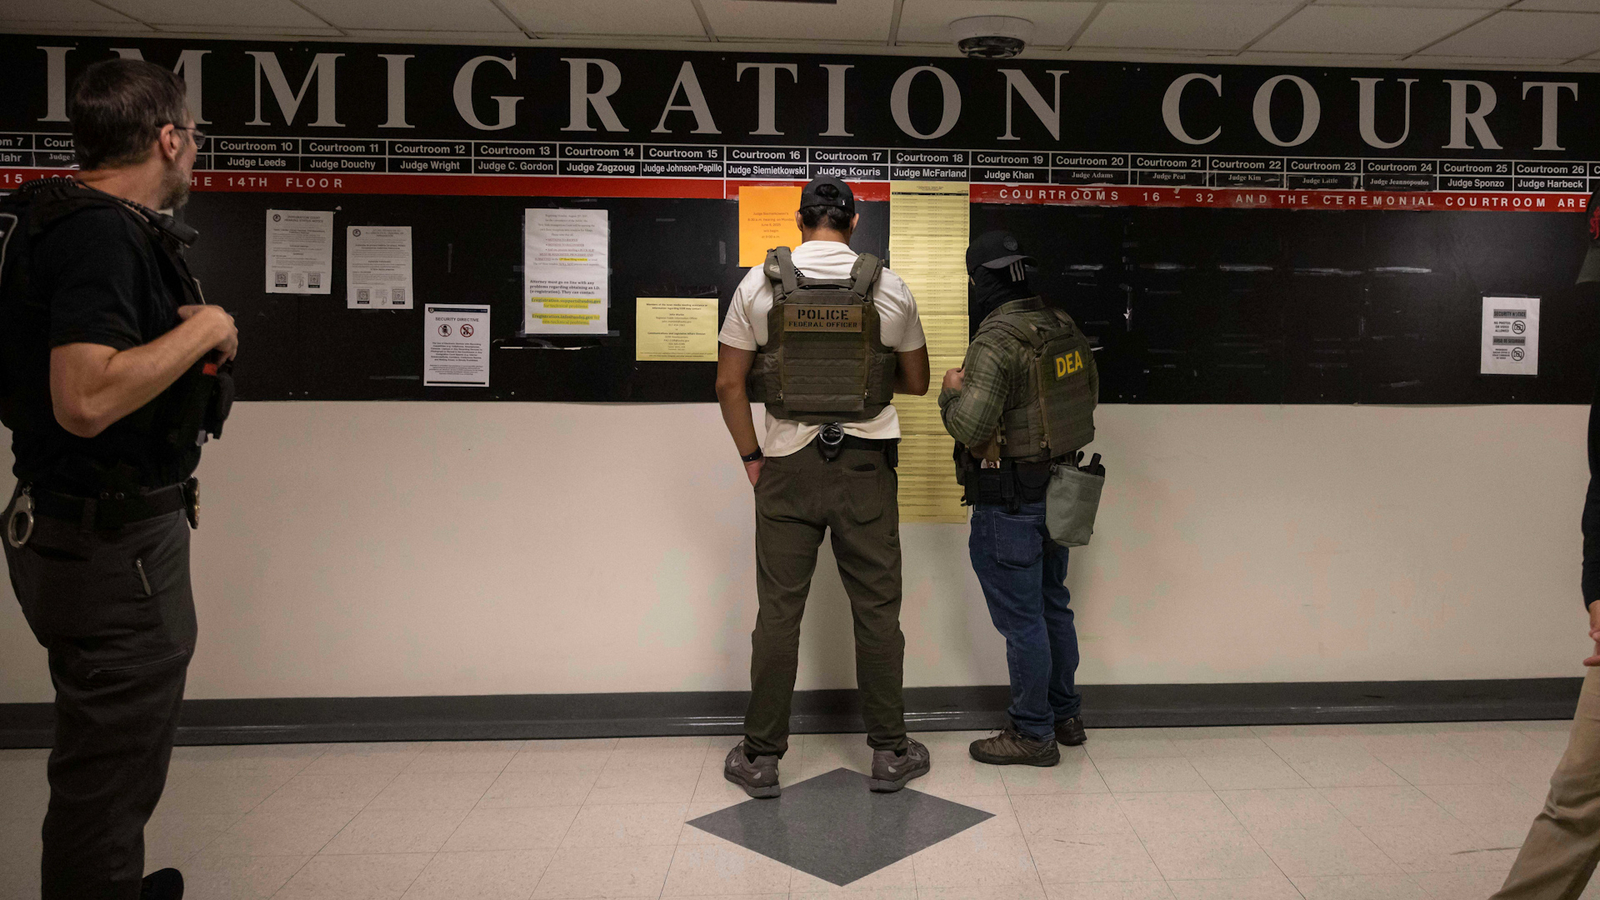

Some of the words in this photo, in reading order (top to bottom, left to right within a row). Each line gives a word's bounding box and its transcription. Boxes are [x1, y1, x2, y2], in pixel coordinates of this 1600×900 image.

[37, 46, 1070, 141] IMMIGRATION
[1162, 72, 1579, 151] COURT
[17, 137, 24, 147] 7
[44, 138, 75, 148] Court
[220, 141, 276, 151] Courtroom
[281, 142, 292, 151] 10
[309, 143, 365, 153] Courtroom
[370, 144, 379, 153] 11
[395, 144, 450, 154] Courtroom
[454, 145, 465, 154] 12
[480, 146, 535, 155] Courtroom
[539, 146, 550, 156] 13
[565, 147, 619, 157] Courtroom
[623, 148, 634, 157] 14
[649, 148, 703, 158] Courtroom
[707, 149, 718, 158] 15
[49, 153, 70, 162] Judge
[732, 150, 786, 160] Courtroom
[789, 151, 800, 160] 16
[815, 152, 868, 161] Courtroom
[872, 152, 882, 162] 17
[896, 153, 948, 163] Courtroom
[953, 154, 963, 163] 18
[977, 154, 1029, 164] Courtroom
[1033, 155, 1044, 164] 19
[227, 157, 257, 168] Judge
[259, 158, 286, 167] Leeds
[310, 159, 339, 170] Judge
[341, 160, 376, 171] Douchy
[400, 160, 429, 171] Judge
[431, 161, 460, 172] Wright
[1056, 156, 1108, 166] Courtroom
[1111, 157, 1124, 166] 20
[1136, 158, 1187, 167] Courtroom
[1190, 158, 1201, 168] 21
[1212, 159, 1264, 169] Courtroom
[1268, 160, 1281, 169] 22
[1291, 161, 1340, 171] Courtroom
[1344, 162, 1356, 171] 23
[478, 161, 506, 172] Judge
[508, 162, 518, 171] C.
[520, 162, 554, 172] Gordon
[567, 163, 595, 173] Judge
[597, 163, 635, 174] Zagzoug
[643, 164, 665, 174] Judge
[666, 164, 722, 175] Johnson-Papillo
[728, 165, 750, 176] Judge
[752, 165, 806, 176] Siemietkowski
[817, 166, 848, 177] Judge
[850, 166, 881, 176] Kouris
[1368, 162, 1418, 172] Courtroom
[1420, 163, 1432, 172] 24
[1444, 164, 1493, 173] Courtroom
[1496, 164, 1508, 174] 25
[1517, 165, 1568, 175] Courtroom
[1572, 166, 1585, 175] 26
[894, 168, 921, 178] Judge
[922, 168, 967, 178] McFarland
[984, 170, 1010, 180] Judge
[1012, 170, 1035, 180] Khan
[1071, 172, 1091, 180] Judge
[1152, 173, 1172, 181] Judge
[1228, 174, 1247, 182] Judge
[4, 174, 23, 184] 15
[190, 178, 213, 187] HE
[228, 178, 268, 187] 14TH
[286, 178, 342, 188] FLOOR
[1302, 177, 1321, 185] Judge
[1370, 178, 1388, 186] Judge
[1448, 179, 1473, 189] Judge
[1474, 179, 1505, 189] Sponzo
[1518, 179, 1545, 190] Judge
[1547, 179, 1584, 189] Harbeck
[1000, 189, 1119, 201] COURTROOMS
[1143, 192, 1160, 202] 16
[1196, 193, 1214, 203] 32
[1235, 194, 1267, 204] AND
[1279, 194, 1309, 204] THE
[1323, 195, 1434, 206] CEREMONIAL
[1445, 196, 1546, 208] COURTROOM
[1557, 198, 1587, 208] ARE
[797, 309, 849, 320] POLICE
[1056, 351, 1083, 378] DEA
